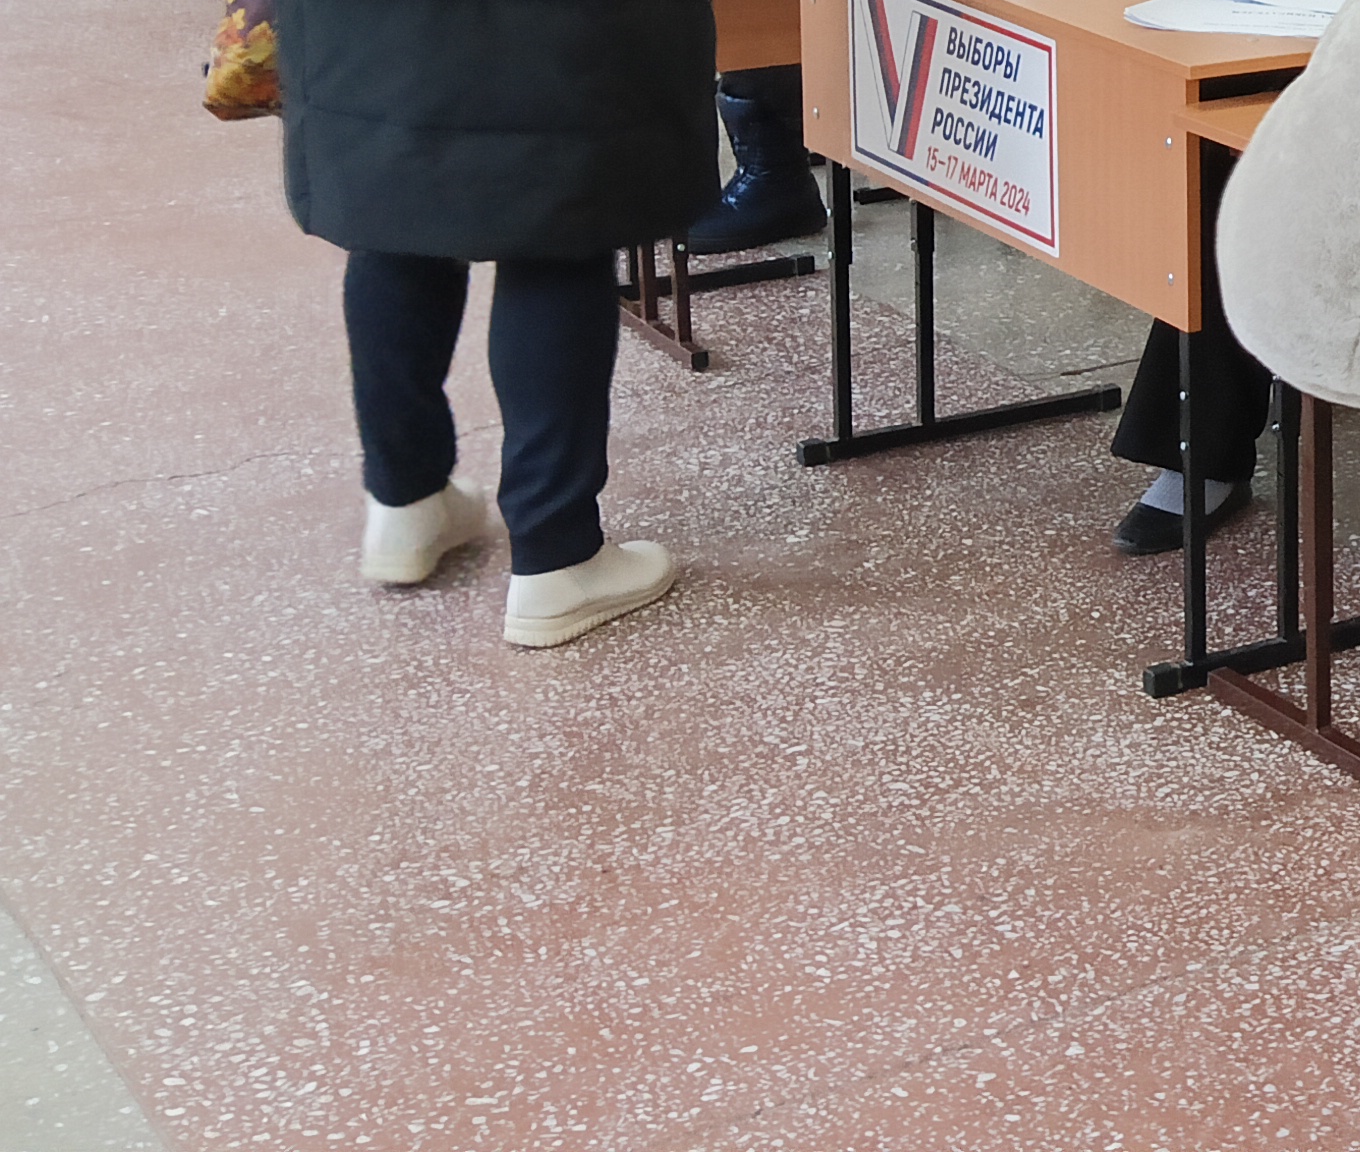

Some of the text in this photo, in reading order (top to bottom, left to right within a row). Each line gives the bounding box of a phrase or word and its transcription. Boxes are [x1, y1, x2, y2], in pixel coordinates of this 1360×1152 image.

[946, 26, 1021, 83] ВЫБОРЫ
[938, 67, 1045, 140] ПРЕЗИДЕНТА
[931, 107, 999, 162] РОССИИ
[959, 162, 998, 201] МАРТА
[1000, 181, 1031, 217] 2024
